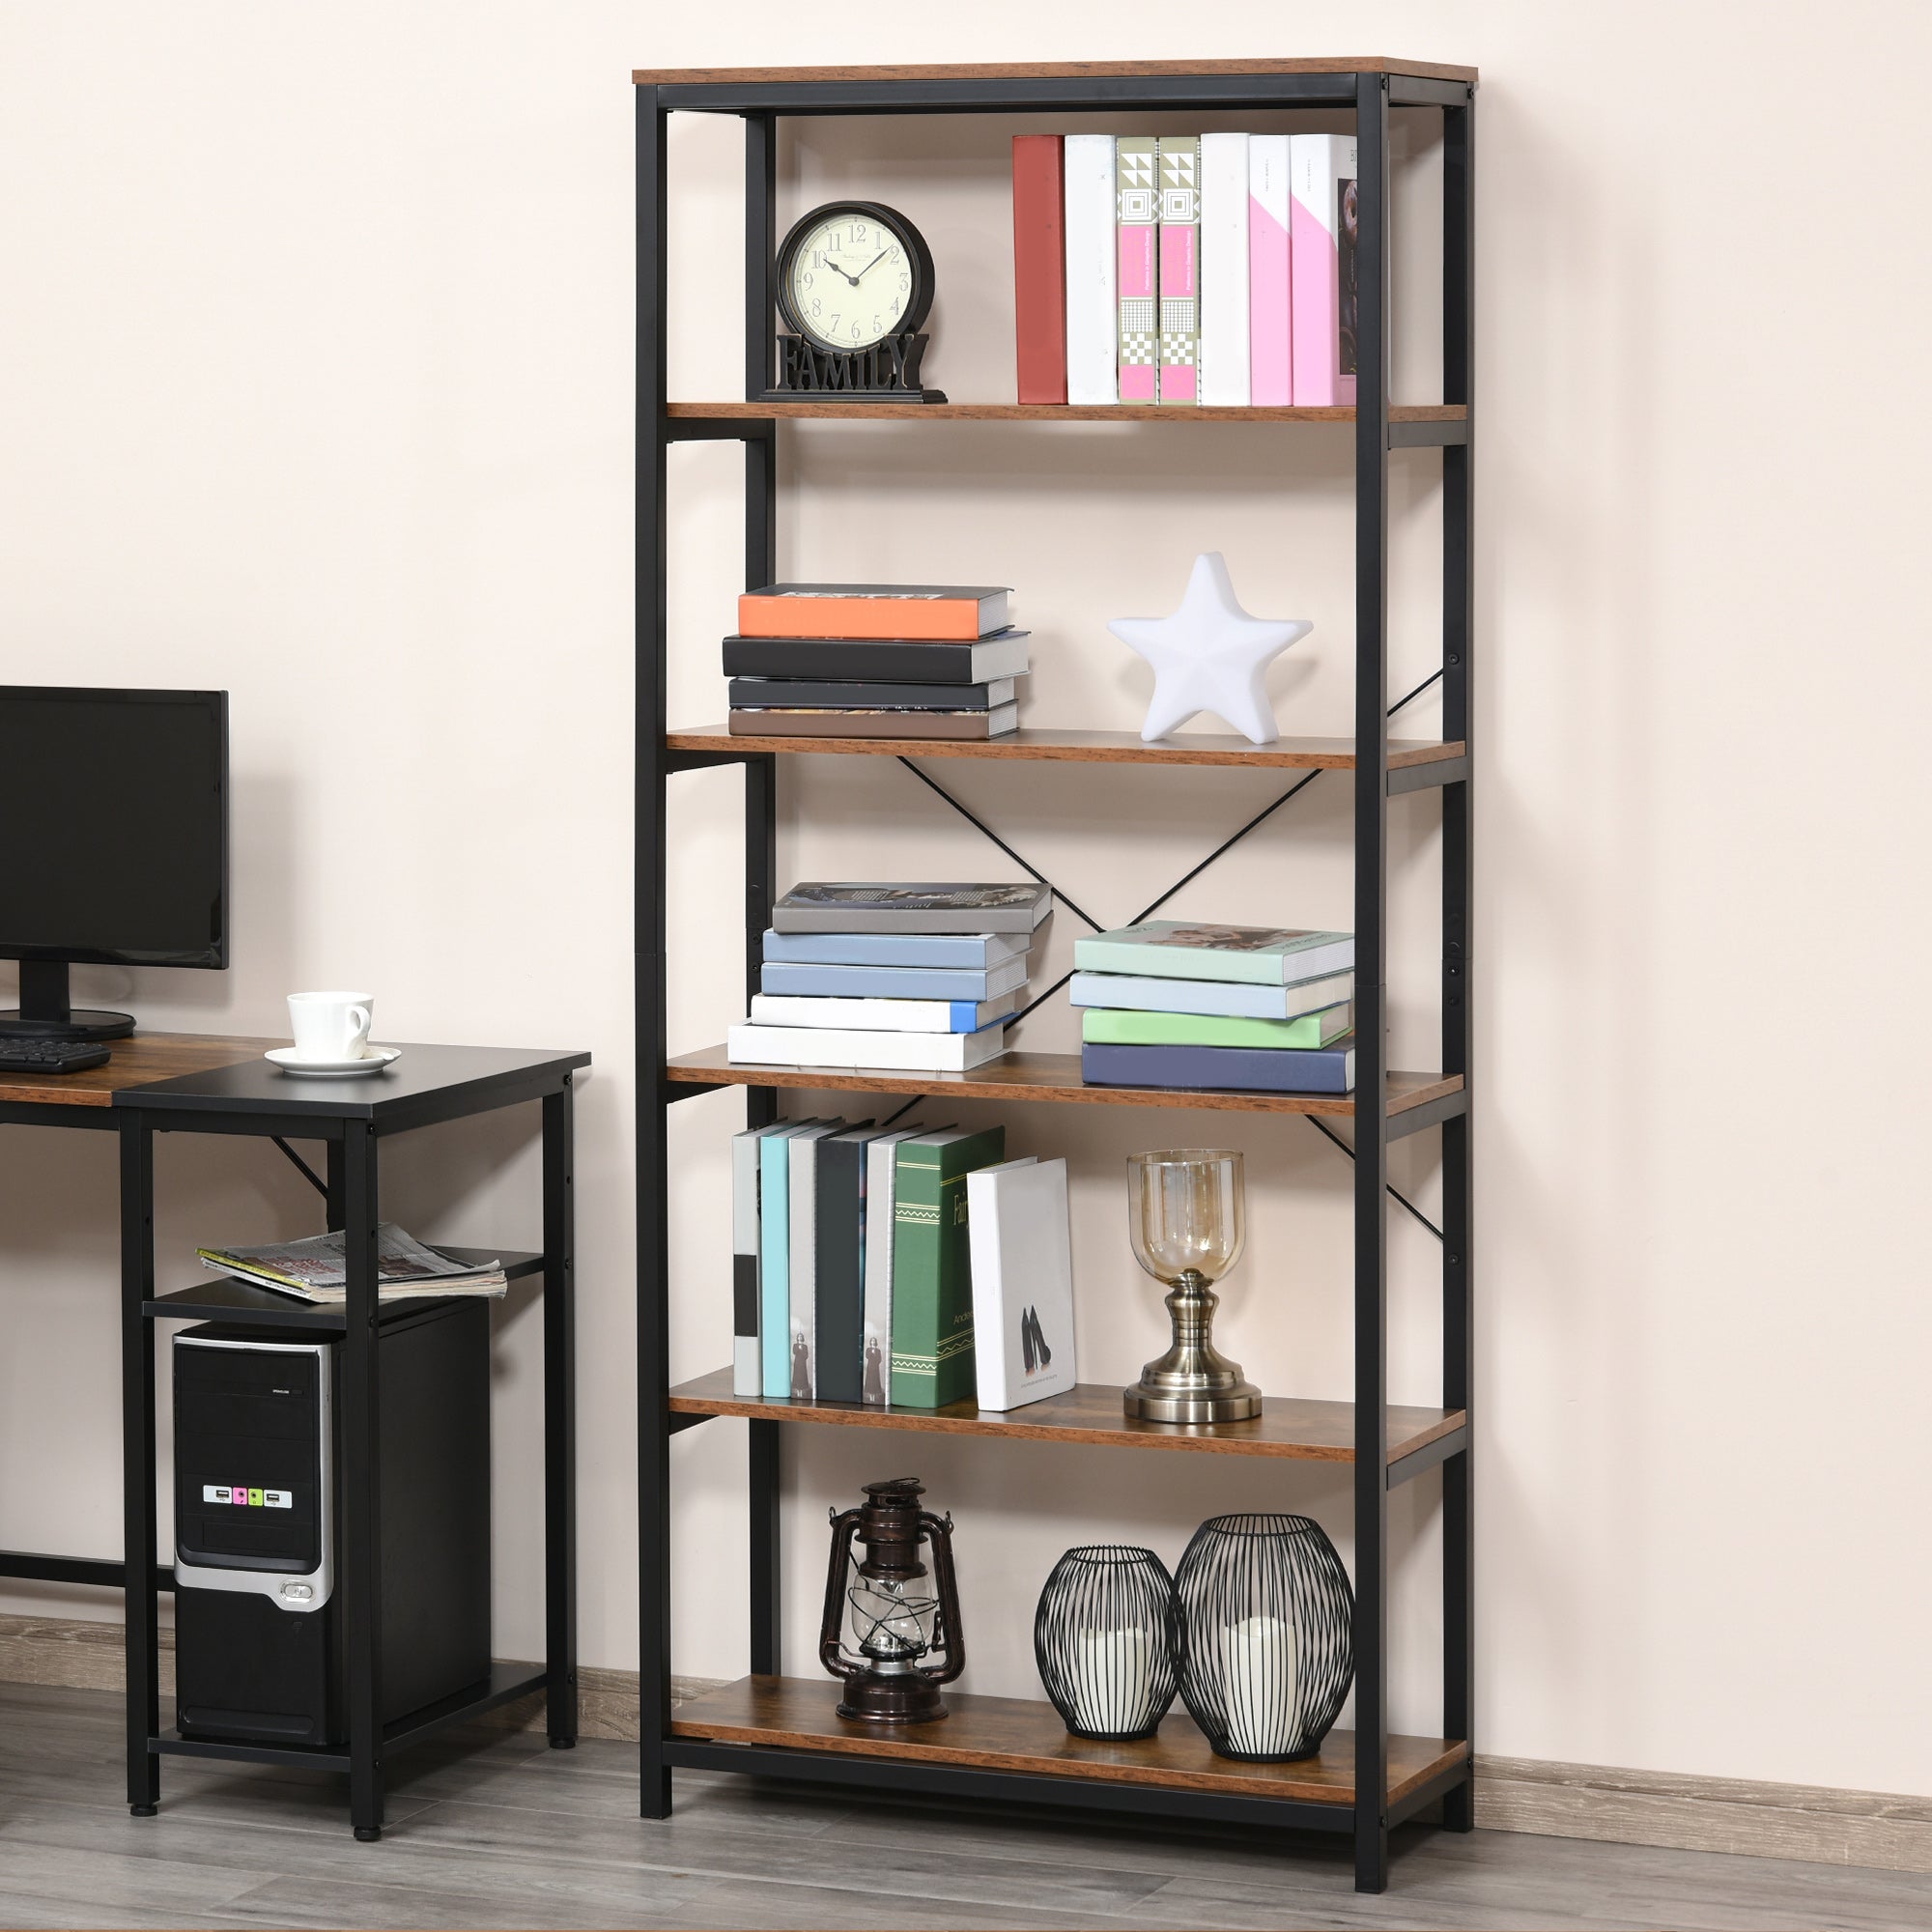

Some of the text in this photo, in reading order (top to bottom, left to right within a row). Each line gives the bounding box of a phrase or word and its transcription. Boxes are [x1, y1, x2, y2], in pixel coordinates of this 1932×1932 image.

[827, 233, 842, 251] 11
[848, 224, 867, 242] 12
[874, 231, 883, 250] 1
[812, 250, 828, 269] 10
[890, 245, 900, 266] 2
[804, 272, 813, 291] 9
[899, 272, 909, 292] 3
[811, 298, 822, 317] 8
[890, 297, 899, 316] 4
[831, 314, 840, 332] 7
[851, 320, 861, 339] 6
[872, 315, 883, 333] 5
[777, 333, 915, 390] FAMILY
